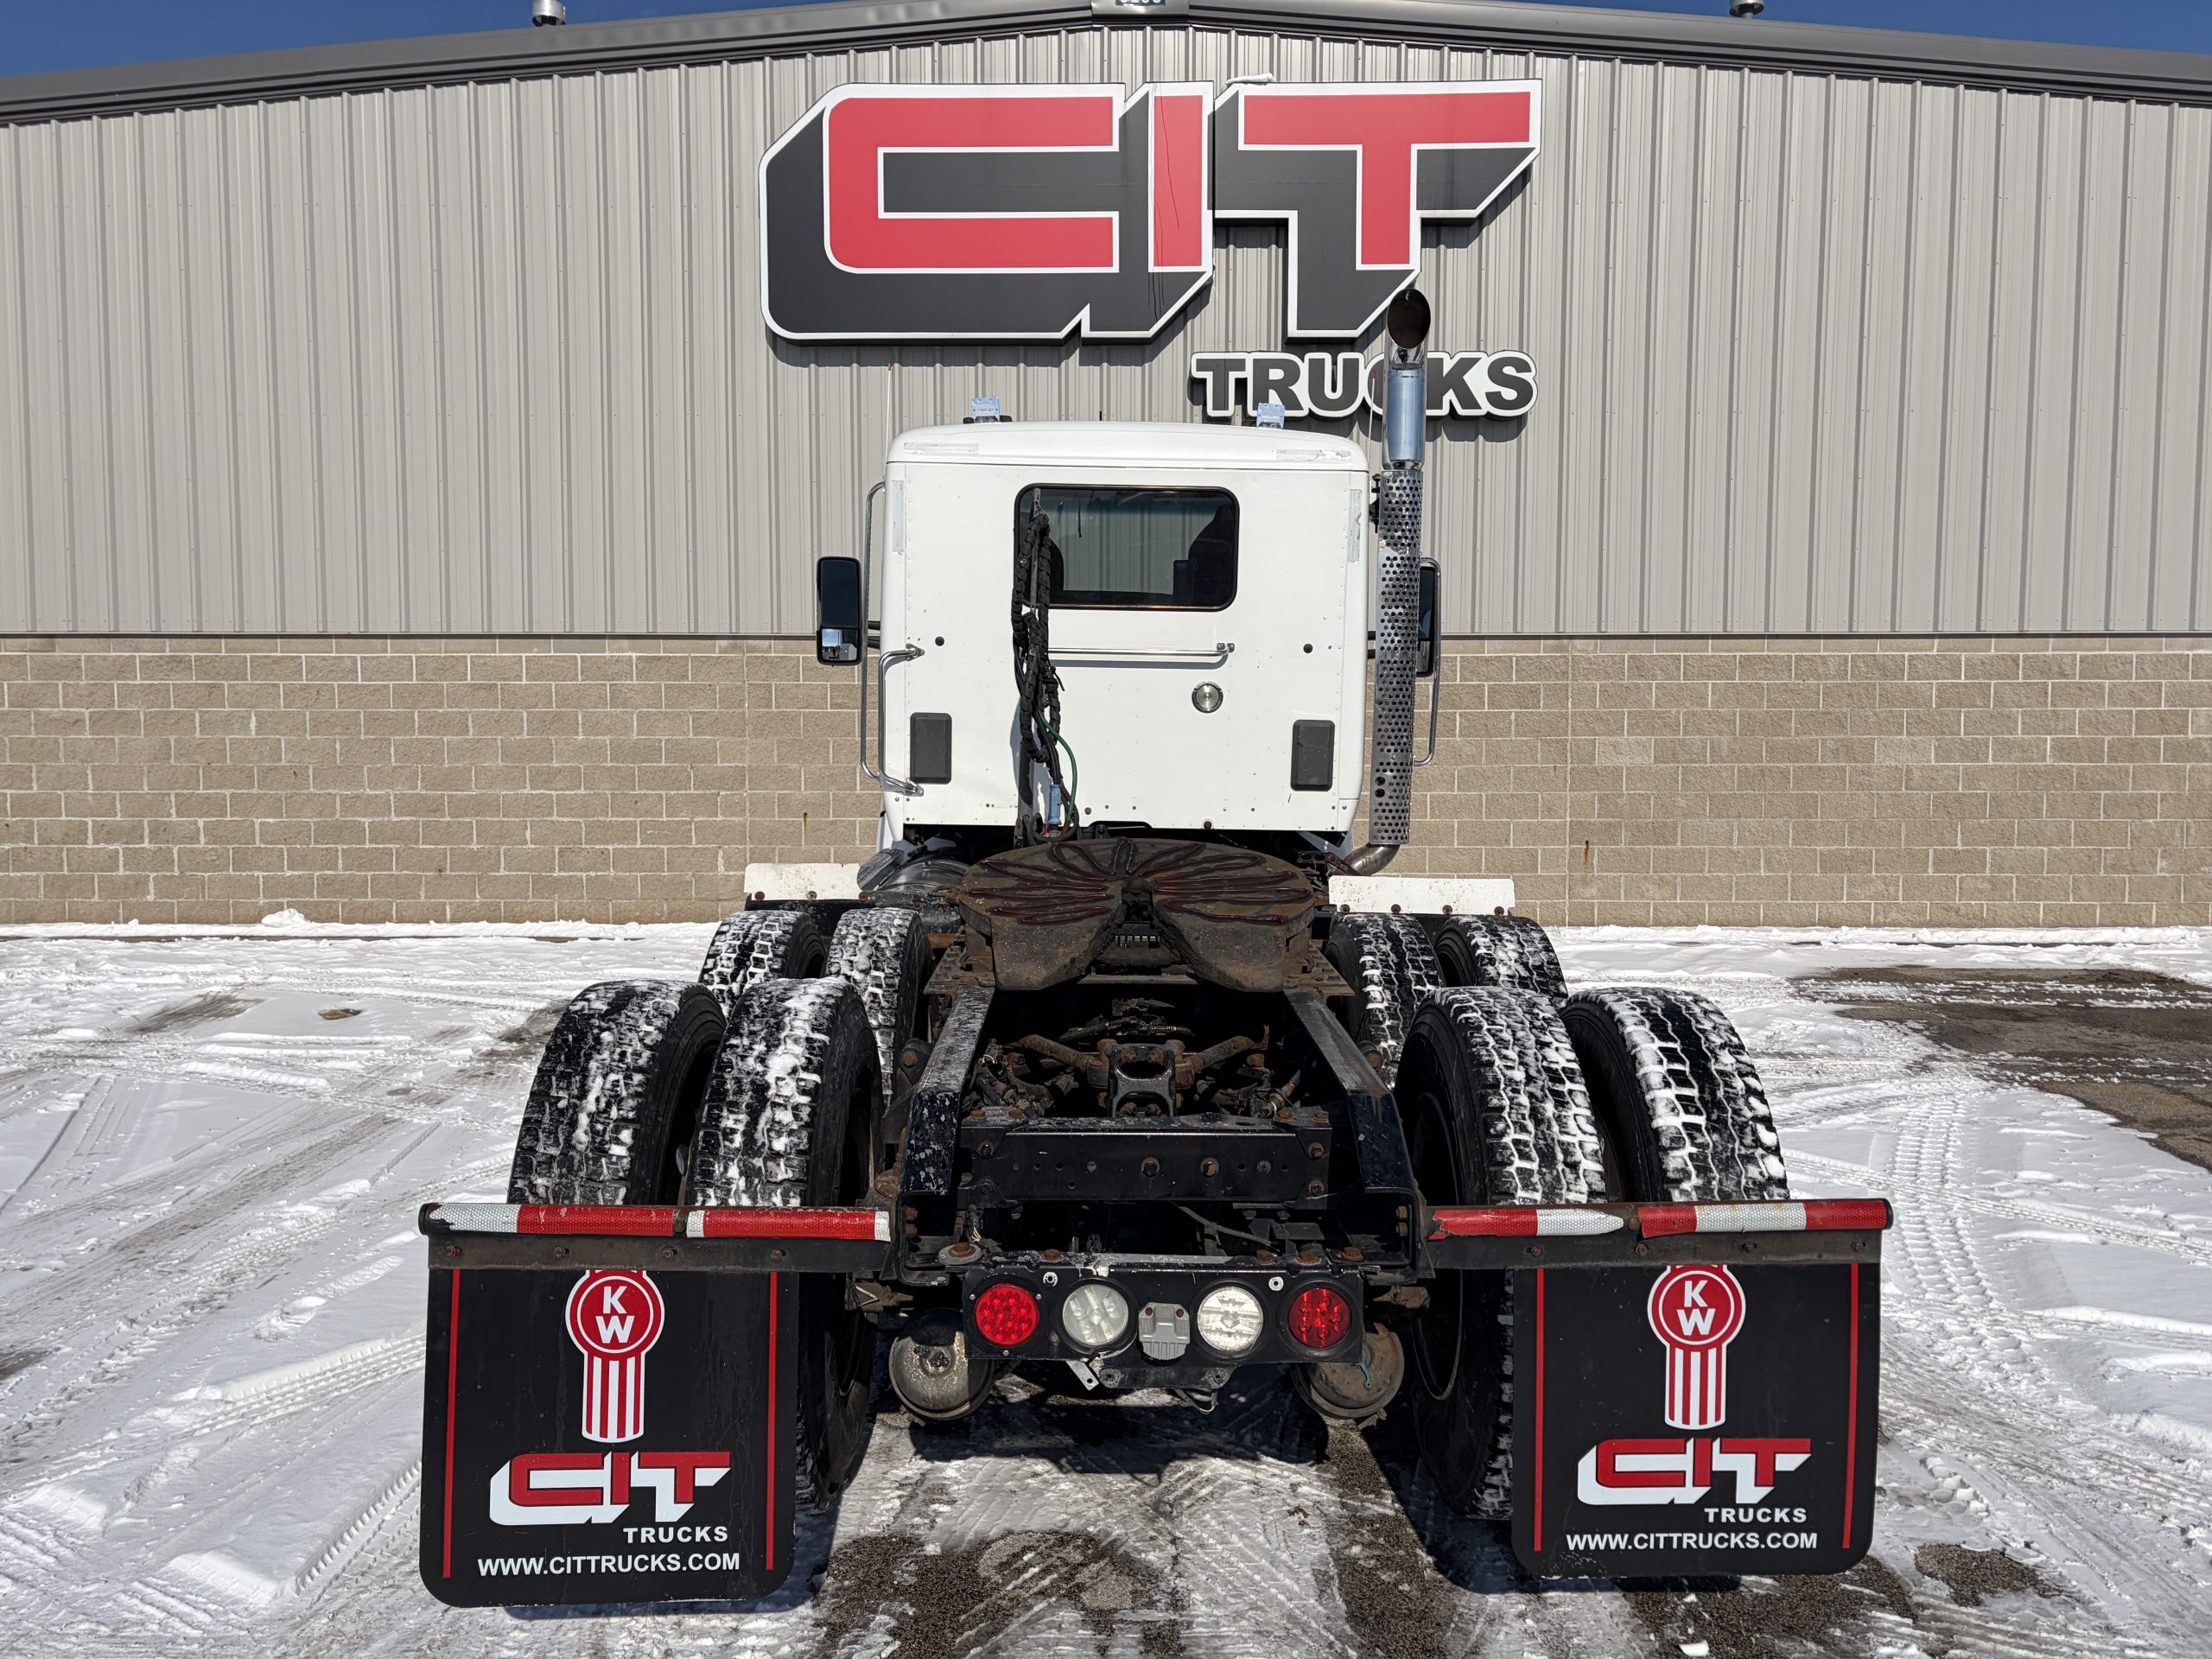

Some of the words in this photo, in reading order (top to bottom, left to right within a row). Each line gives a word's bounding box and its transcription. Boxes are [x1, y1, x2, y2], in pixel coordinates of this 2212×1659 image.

[761, 81, 1541, 340] CIT
[603, 1286, 627, 1314] K
[1683, 1280, 1708, 1308] K
[595, 1315, 635, 1344] W
[1676, 1308, 1715, 1336] W
[1578, 1438, 1811, 1505] CIT
[490, 1452, 731, 1525] CIT
[1704, 1508, 1807, 1523] TRUCKS
[623, 1527, 728, 1543] TRUCKS
[1566, 1533, 1817, 1551] WWW.CITTRUCKS.COM
[478, 1553, 740, 1576] WWW.CITTRUCKS.COM
